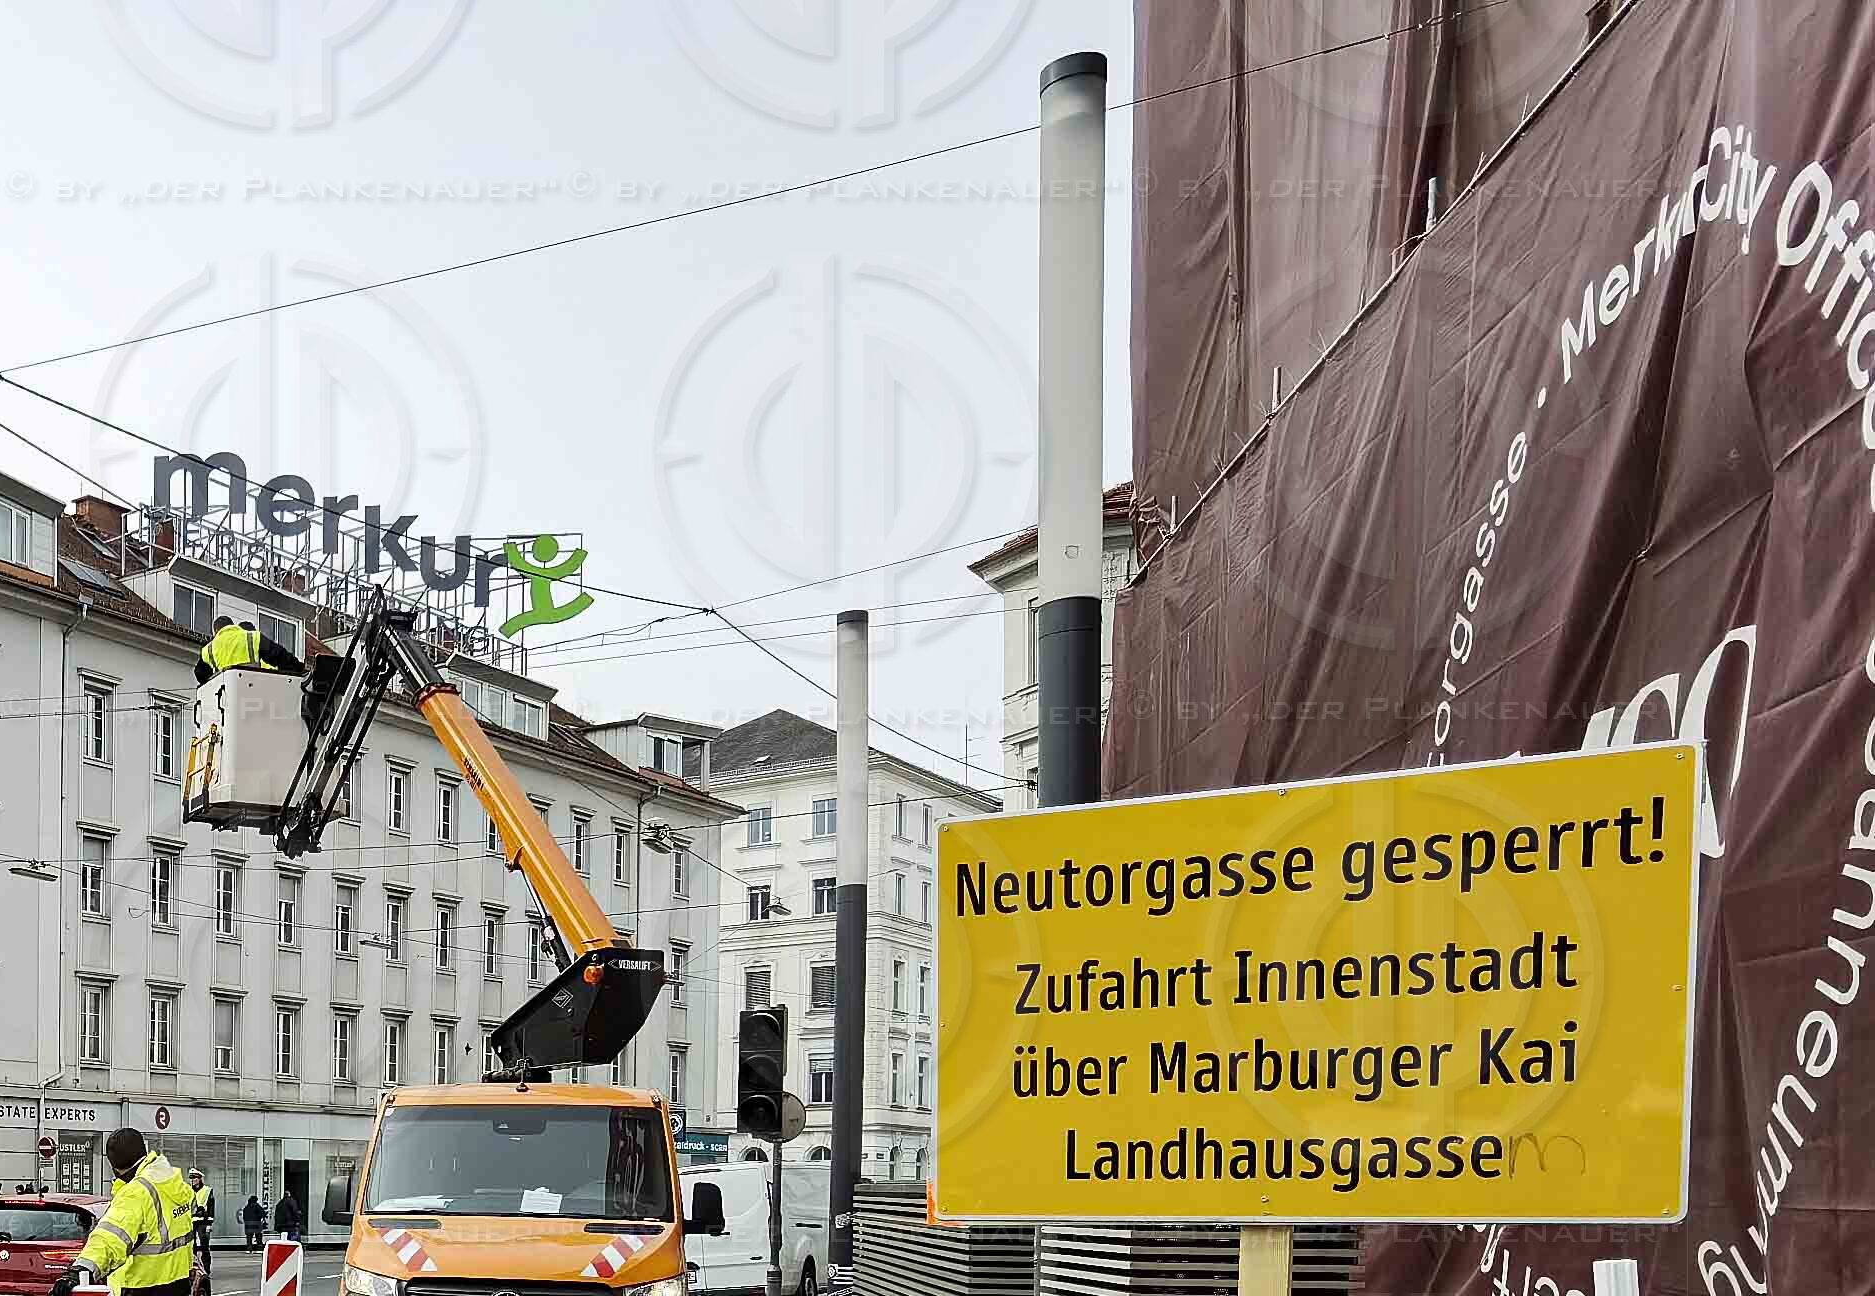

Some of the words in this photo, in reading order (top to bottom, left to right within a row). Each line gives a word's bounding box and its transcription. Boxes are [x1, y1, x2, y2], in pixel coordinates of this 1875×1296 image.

[153, 450, 509, 608] merkur
[956, 846, 1314, 917] Neutorgasse
[1341, 796, 1664, 902] gesperrt!
[1015, 957, 1213, 1015] Zufahrt
[1233, 931, 1578, 1004] Innenstadt
[1013, 1045, 1128, 1098] über
[1150, 1038, 1453, 1103] Marburger
[1479, 1020, 1578, 1085] Kai
[44, 1107, 96, 1122] EXPERTS
[1066, 1127, 1503, 1193] Landhausgasse
